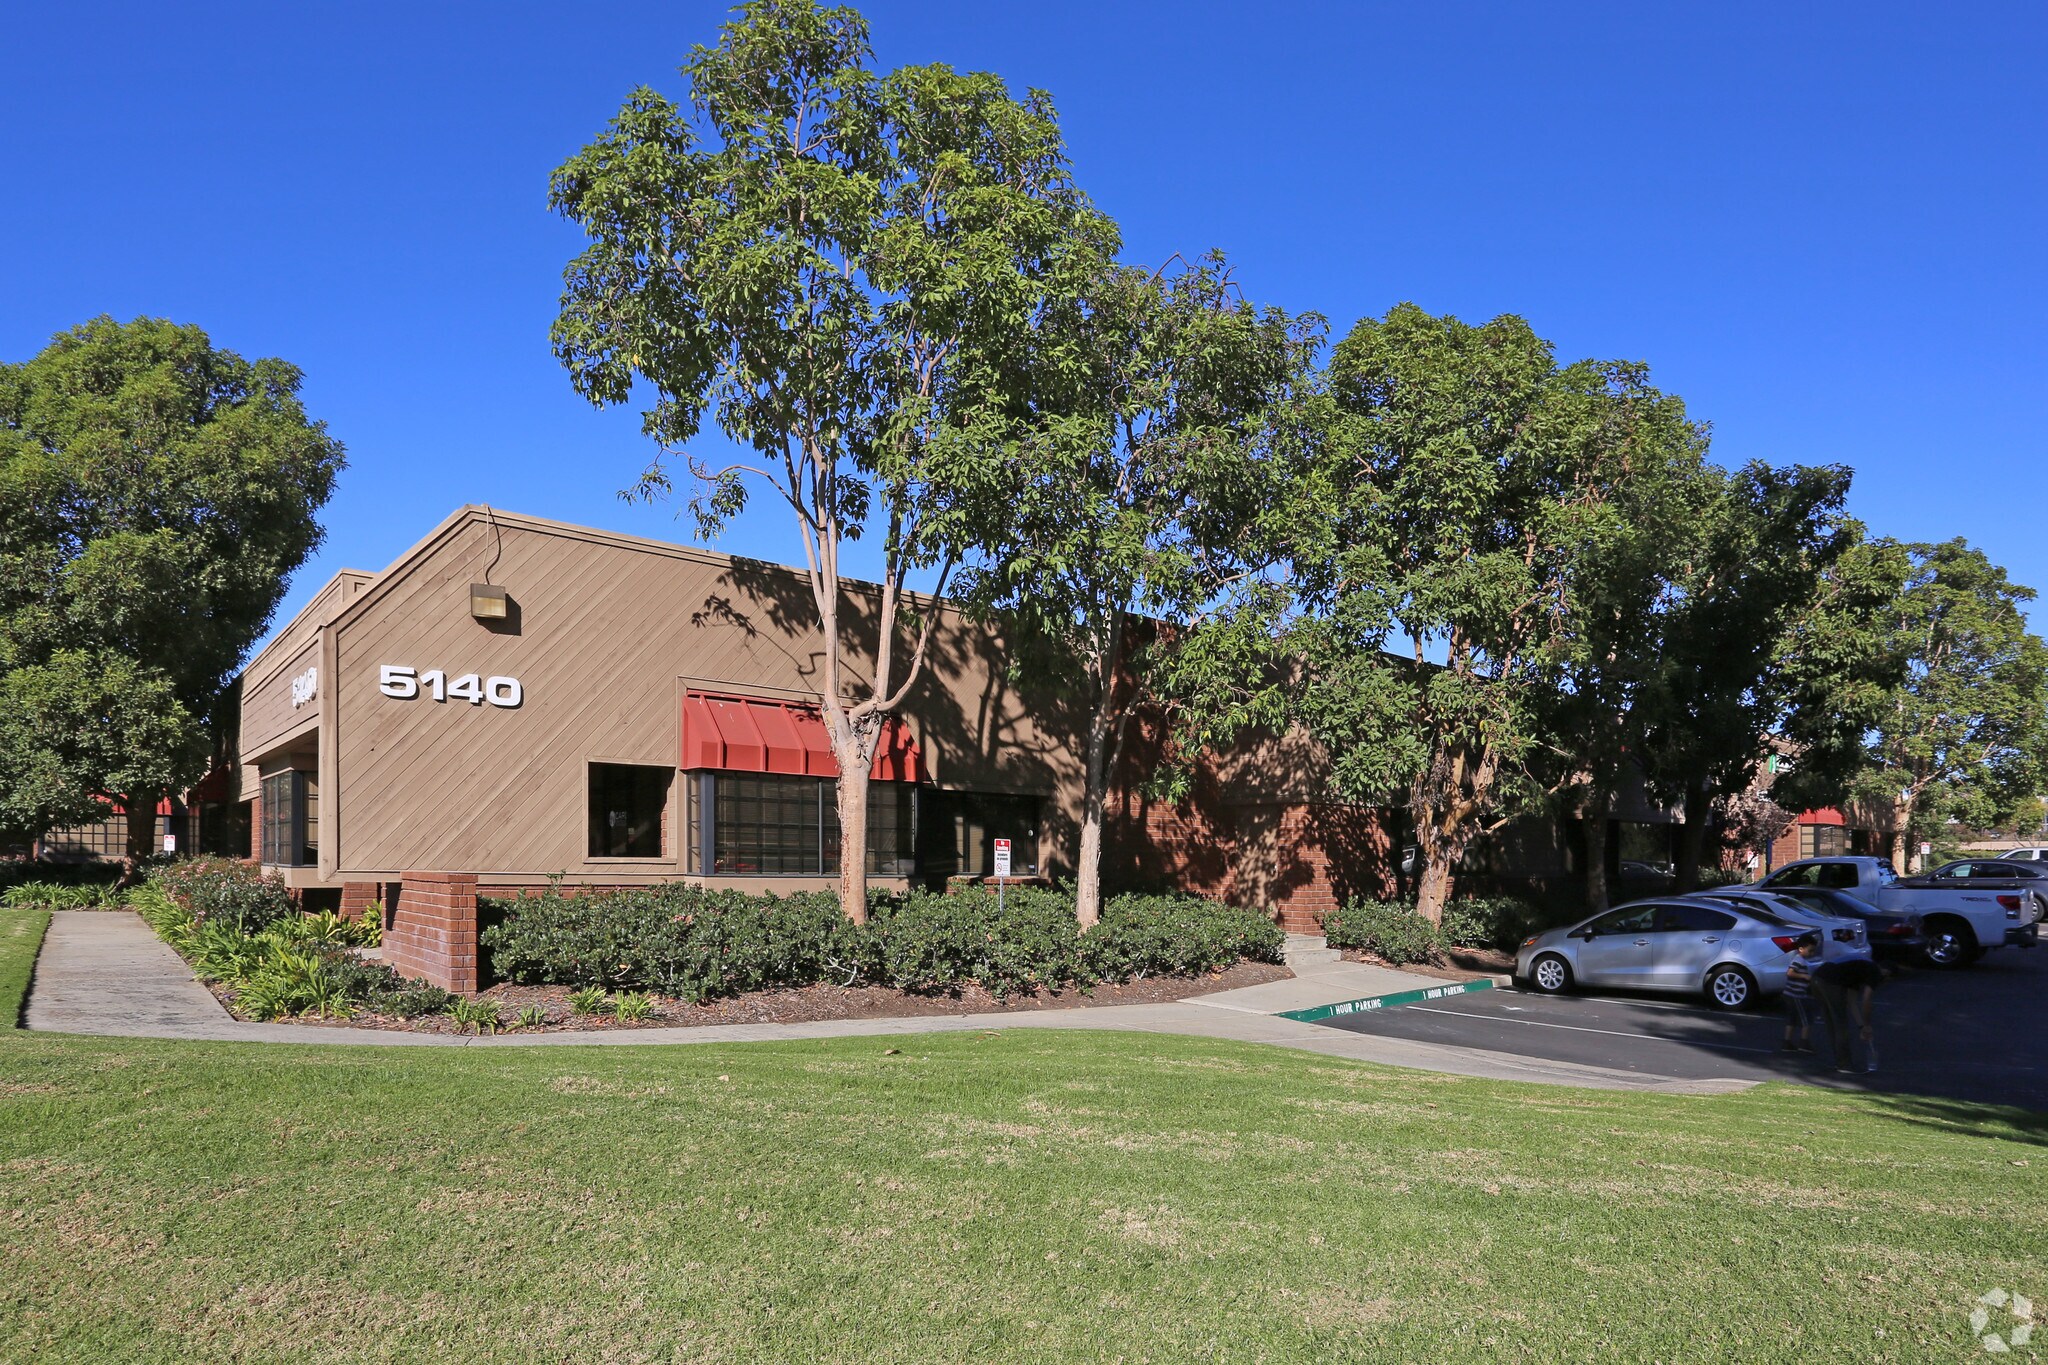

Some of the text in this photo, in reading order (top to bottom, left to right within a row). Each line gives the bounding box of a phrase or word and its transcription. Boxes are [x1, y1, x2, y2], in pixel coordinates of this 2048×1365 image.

[380, 664, 523, 708] 5140
[1423, 984, 1465, 1001] 1 HOUR PARKING
[1329, 999, 1382, 1016] 1 HOUR PARKING
